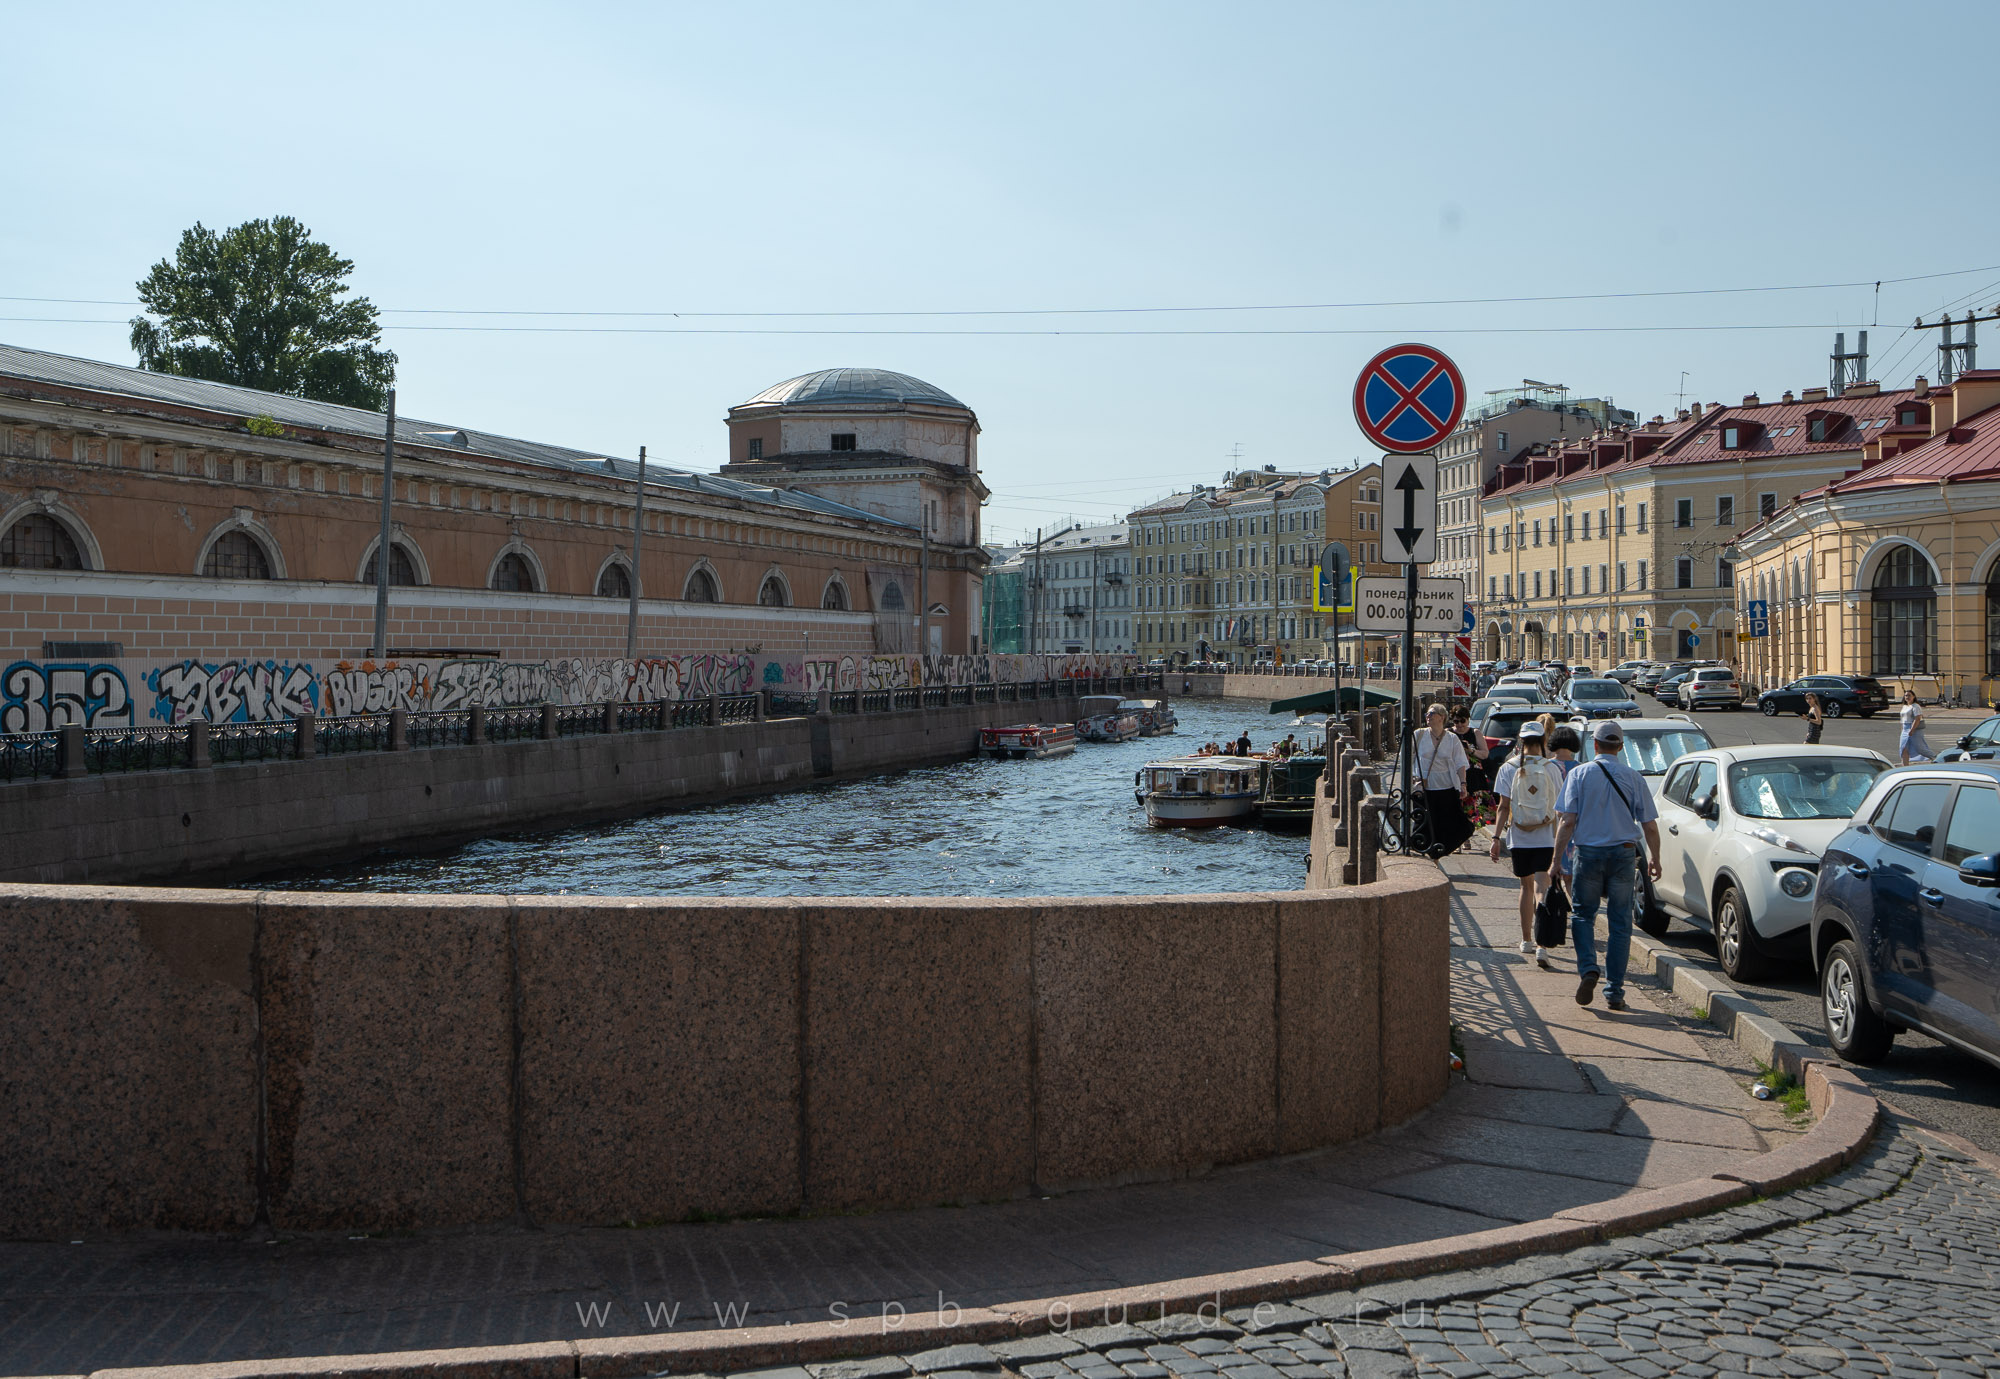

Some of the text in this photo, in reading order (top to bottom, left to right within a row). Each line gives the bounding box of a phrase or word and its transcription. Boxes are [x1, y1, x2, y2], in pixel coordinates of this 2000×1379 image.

[1366, 589, 1454, 600] понедльник
[1754, 620, 1765, 636] P
[1, 662, 134, 747] 352
